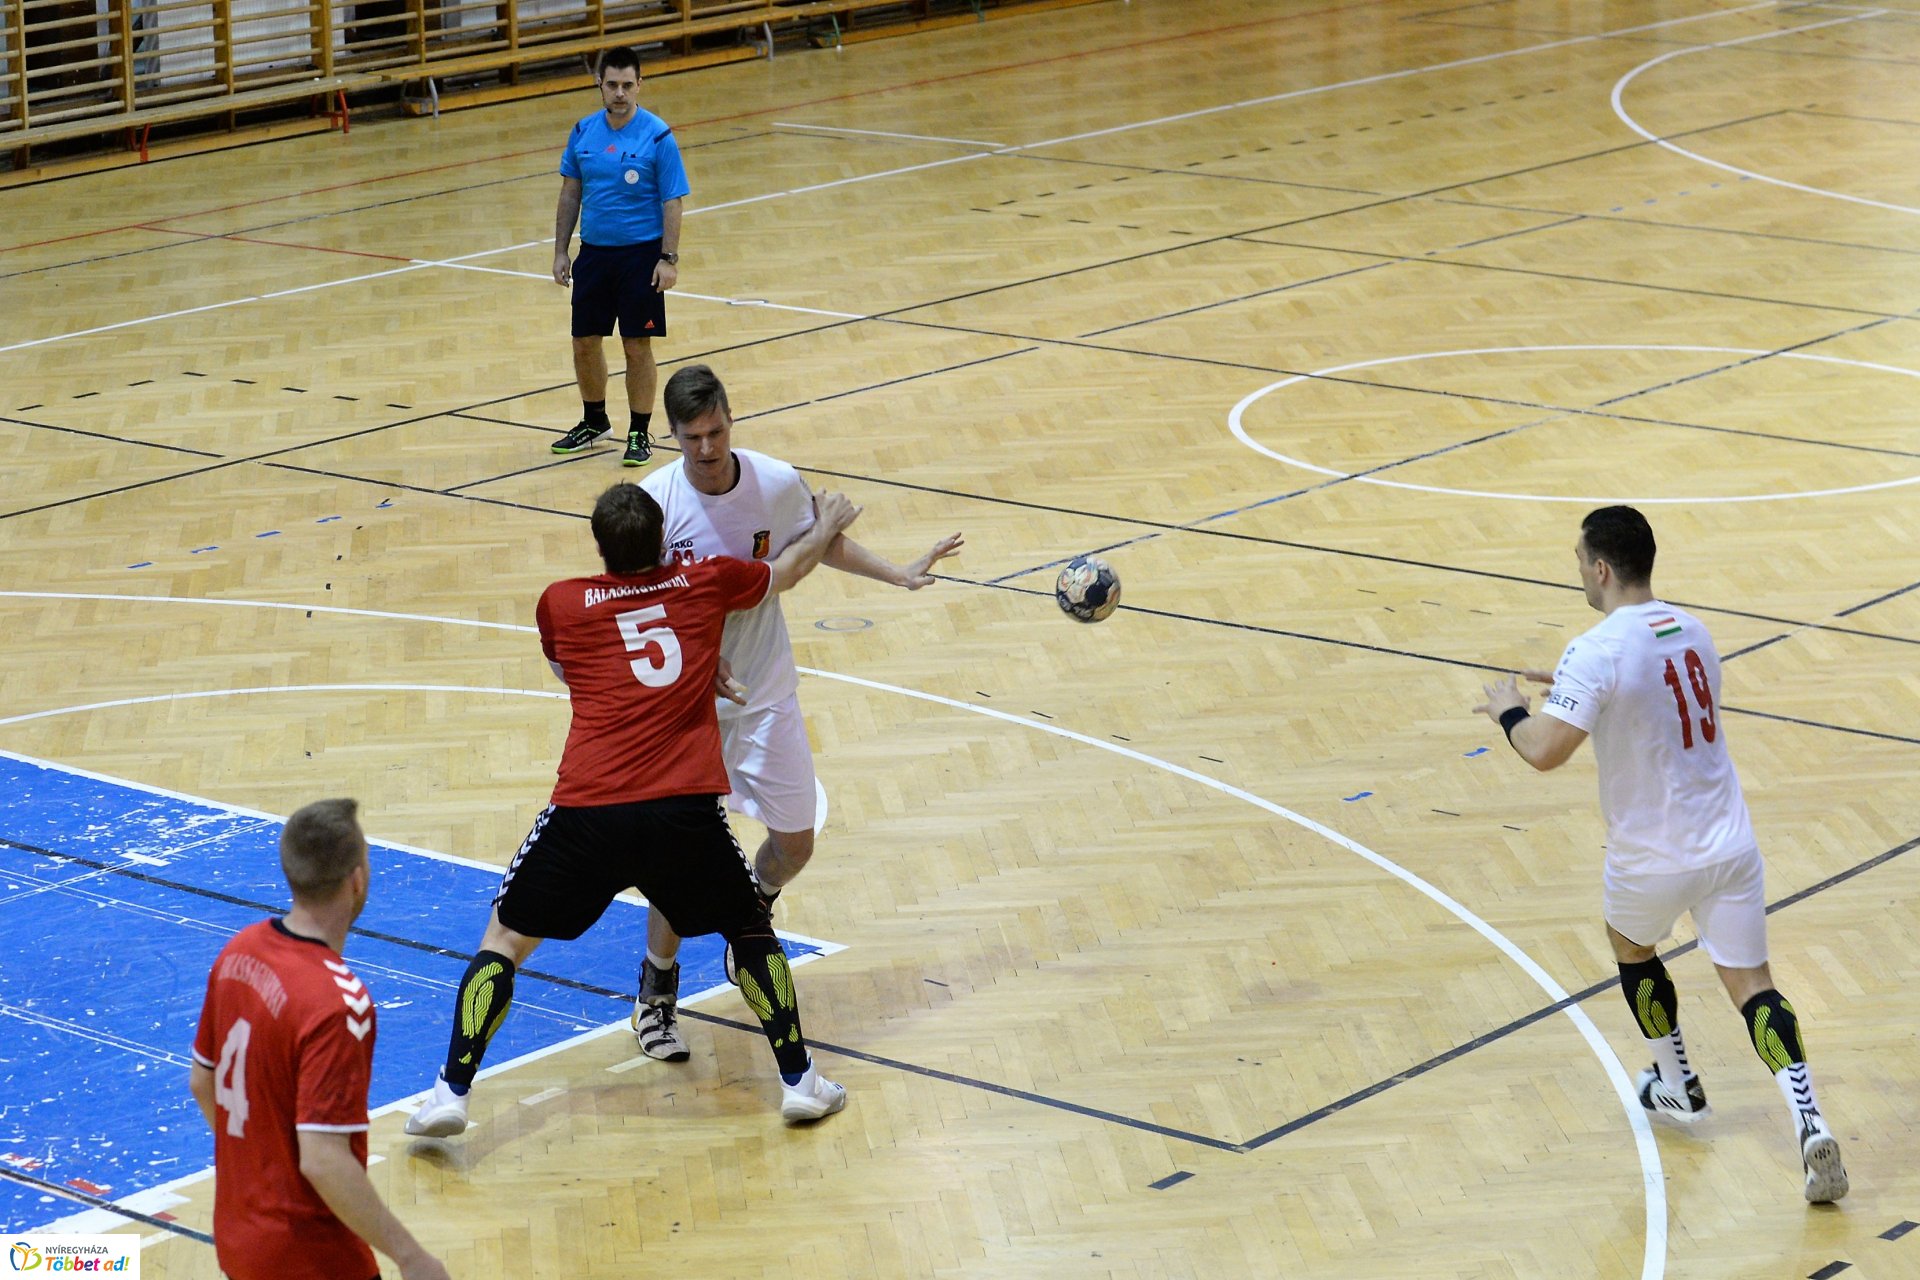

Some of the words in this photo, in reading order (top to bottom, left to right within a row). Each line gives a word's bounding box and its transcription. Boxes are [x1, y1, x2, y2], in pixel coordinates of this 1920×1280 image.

[669, 540, 693, 549] JAKO
[615, 603, 683, 688] 5
[1663, 648, 1716, 750] 19
[214, 1017, 252, 1139] 4
